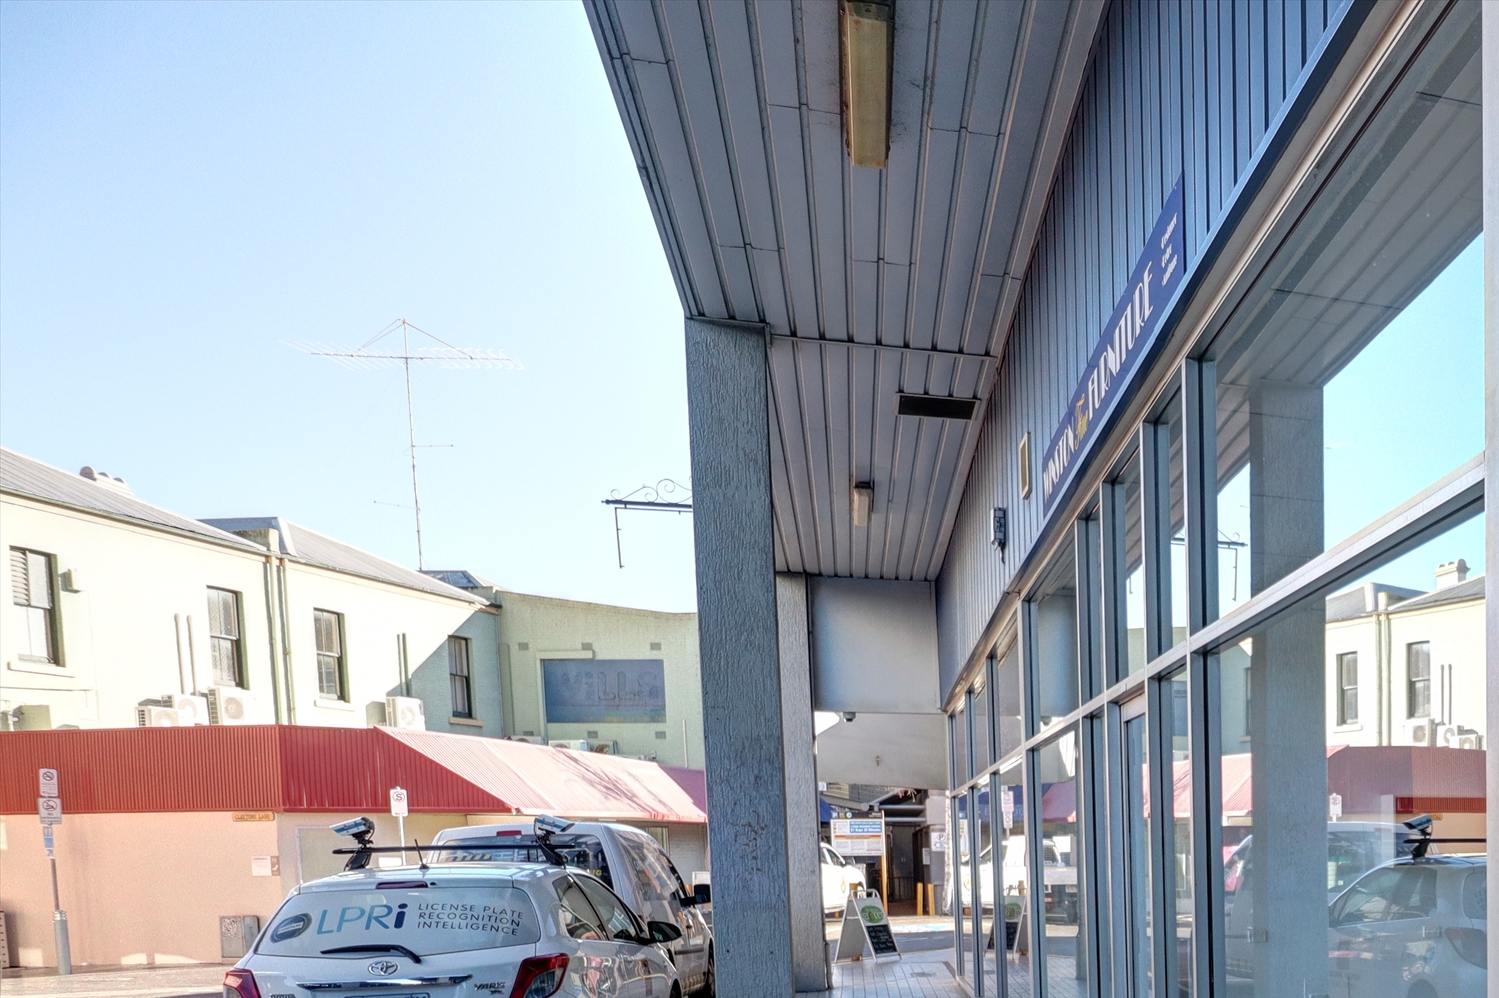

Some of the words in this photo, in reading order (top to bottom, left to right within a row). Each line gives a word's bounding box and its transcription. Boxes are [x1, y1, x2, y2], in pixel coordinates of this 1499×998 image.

[1043, 417, 1075, 503] WINSTON
[1088, 261, 1153, 421] FURNITURE
[316, 903, 409, 935] LPRi
[418, 903, 476, 913] LICENSE
[483, 905, 524, 919] PLATE
[418, 911, 520, 927] RECOGNITION
[417, 920, 519, 936] INTELLIGENCE
